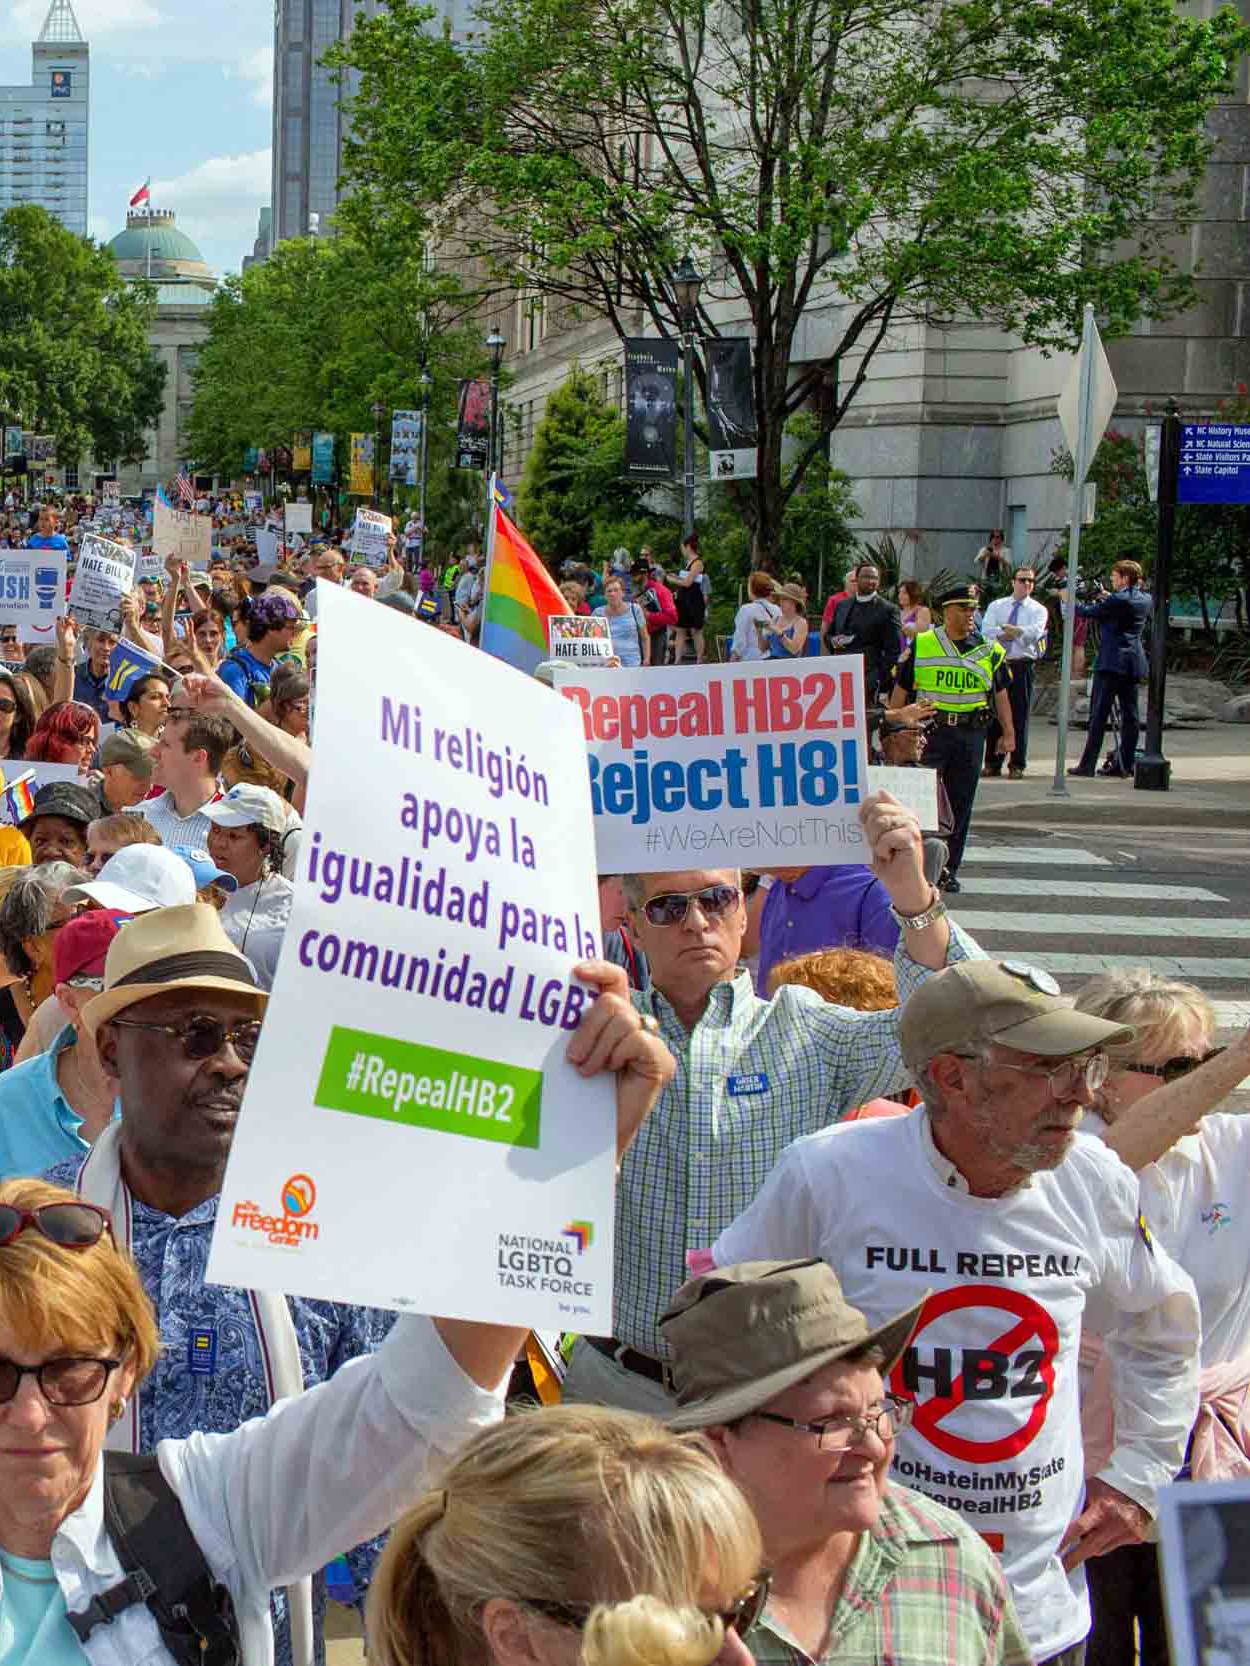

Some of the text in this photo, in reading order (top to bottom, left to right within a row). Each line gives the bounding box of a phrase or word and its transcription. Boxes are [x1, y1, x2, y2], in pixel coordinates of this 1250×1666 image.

[1195, 465, 1238, 476] State Capitol
[82, 557, 103, 572] HATE
[105, 563, 121, 577] BILL
[555, 643, 579, 657] HATE
[581, 643, 602, 656] BILL
[732, 672, 854, 734] HB2!
[380, 695, 549, 806] Mi religión
[757, 739, 860, 808] H8!
[400, 792, 536, 870] apoya la
[646, 817, 862, 852] #WeAreNotThis
[308, 832, 596, 960] igualidad para la
[299, 929, 514, 1014] comunidad
[346, 1051, 516, 1122] #RepealHB2
[232, 1202, 320, 1241] Freedom
[498, 1233, 573, 1255] NATIONAL
[498, 1248, 574, 1277] LGBTQ
[866, 1245, 1082, 1280] FULL REPEAL!
[497, 1272, 594, 1297] TASK FORCE
[902, 1346, 1048, 1399] HB2
